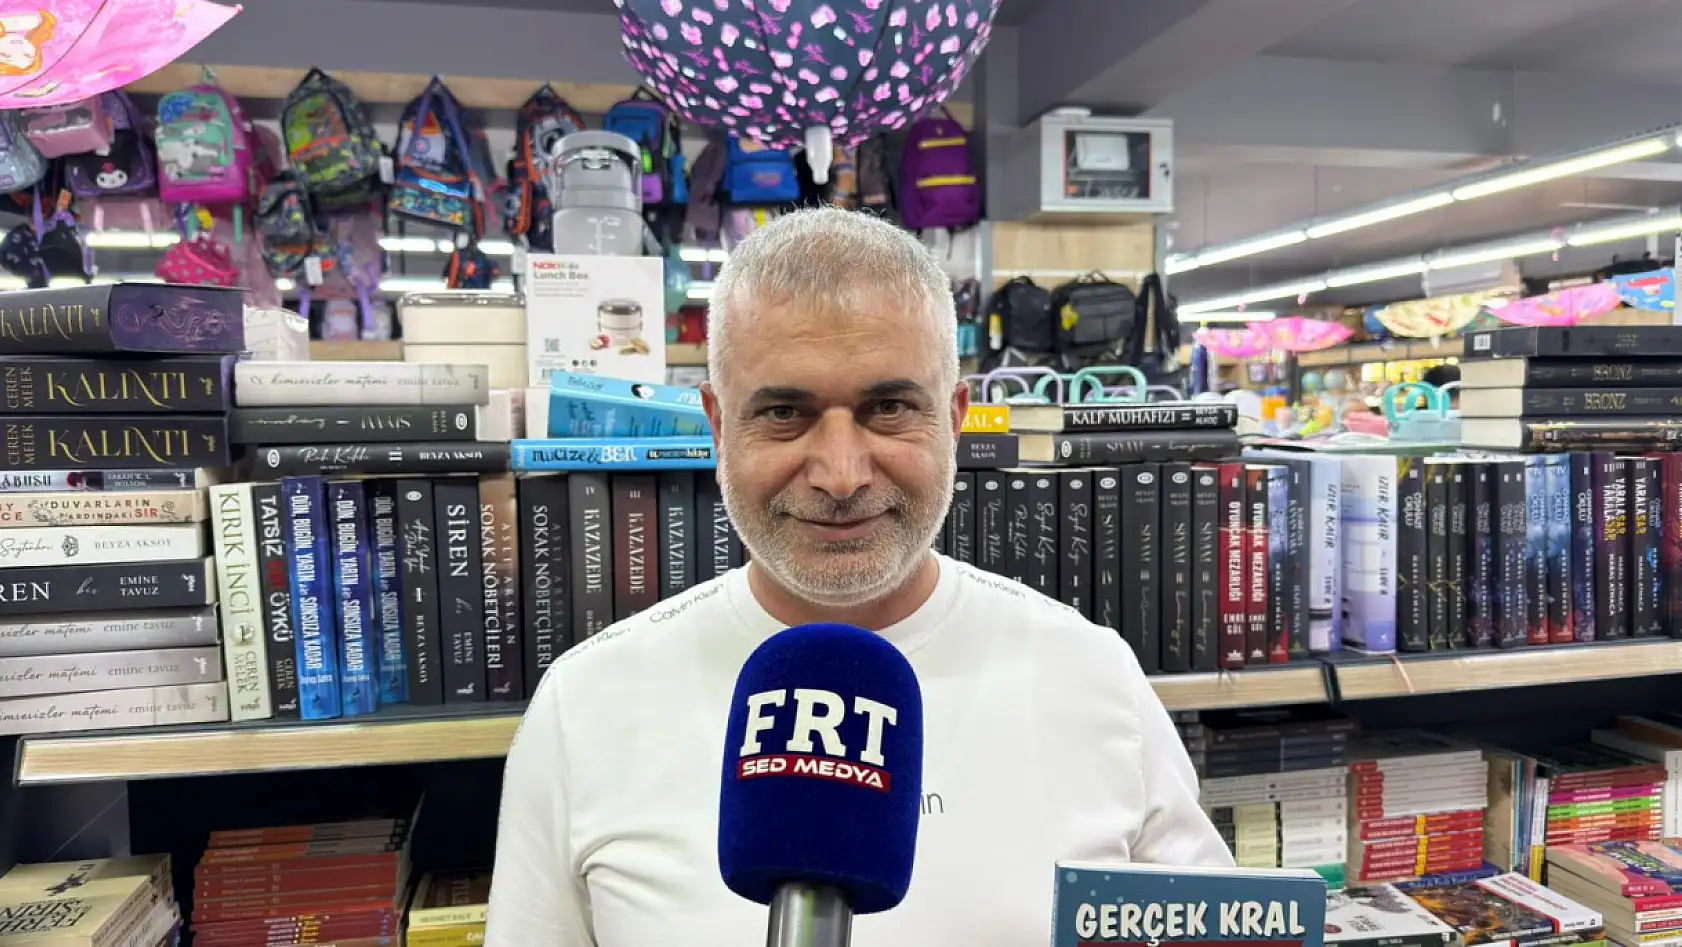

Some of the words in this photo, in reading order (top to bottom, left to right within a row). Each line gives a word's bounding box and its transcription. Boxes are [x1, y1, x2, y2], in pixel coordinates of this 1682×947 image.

[534, 271, 567, 280] Lunch
[569, 271, 589, 280] Box
[47, 369, 187, 408] KALINTI
[1584, 393, 1627, 410] BRONZ
[1072, 411, 1105, 426] KALP
[1108, 409, 1176, 425] MUHAFIZI
[7, 424, 19, 466] CEREN
[22, 424, 35, 466] MELEK
[48, 427, 188, 465] KALINTI
[51, 500, 151, 509] DUVARLARIN
[134, 508, 159, 518] SIR
[219, 492, 244, 558] KIRIK
[1229, 500, 1241, 547] OYUNCAK
[1252, 502, 1265, 549] OYUNCAK
[1633, 477, 1647, 535] YARALASAR
[95, 541, 131, 550] BEYZA
[447, 504, 471, 577] SİREN
[481, 503, 499, 559] SOKAK
[532, 504, 551, 559] SOKAK
[582, 508, 603, 595] KAZAZEDE
[668, 506, 686, 591] KAZAZEDE
[713, 502, 730, 577] KAZAZED
[297, 553, 315, 582] YARIN
[341, 557, 359, 586] YARIN
[628, 512, 646, 596] KAZAZEDE
[1228, 549, 1243, 602] MEZARLIĞI
[120, 574, 159, 586] EMİNE
[120, 586, 159, 597] TAVUZ
[226, 563, 253, 616] İNCİ
[1252, 551, 1266, 604] MEZARLIĞI
[270, 591, 295, 643] ÖYKÜ
[484, 562, 504, 670] NÖBETÇİLERİ
[505, 575, 517, 646] ARSLAN
[650, 596, 693, 624] Calvin
[244, 650, 262, 692] CEREN
[304, 640, 323, 670] KADAR
[346, 642, 365, 672] KADAR
[740, 688, 897, 767] FRT
[742, 758, 787, 777] SED
[793, 757, 884, 789] MEDYA
[1075, 900, 1209, 947] GERÇEK
[1219, 900, 1306, 937] KRAL
